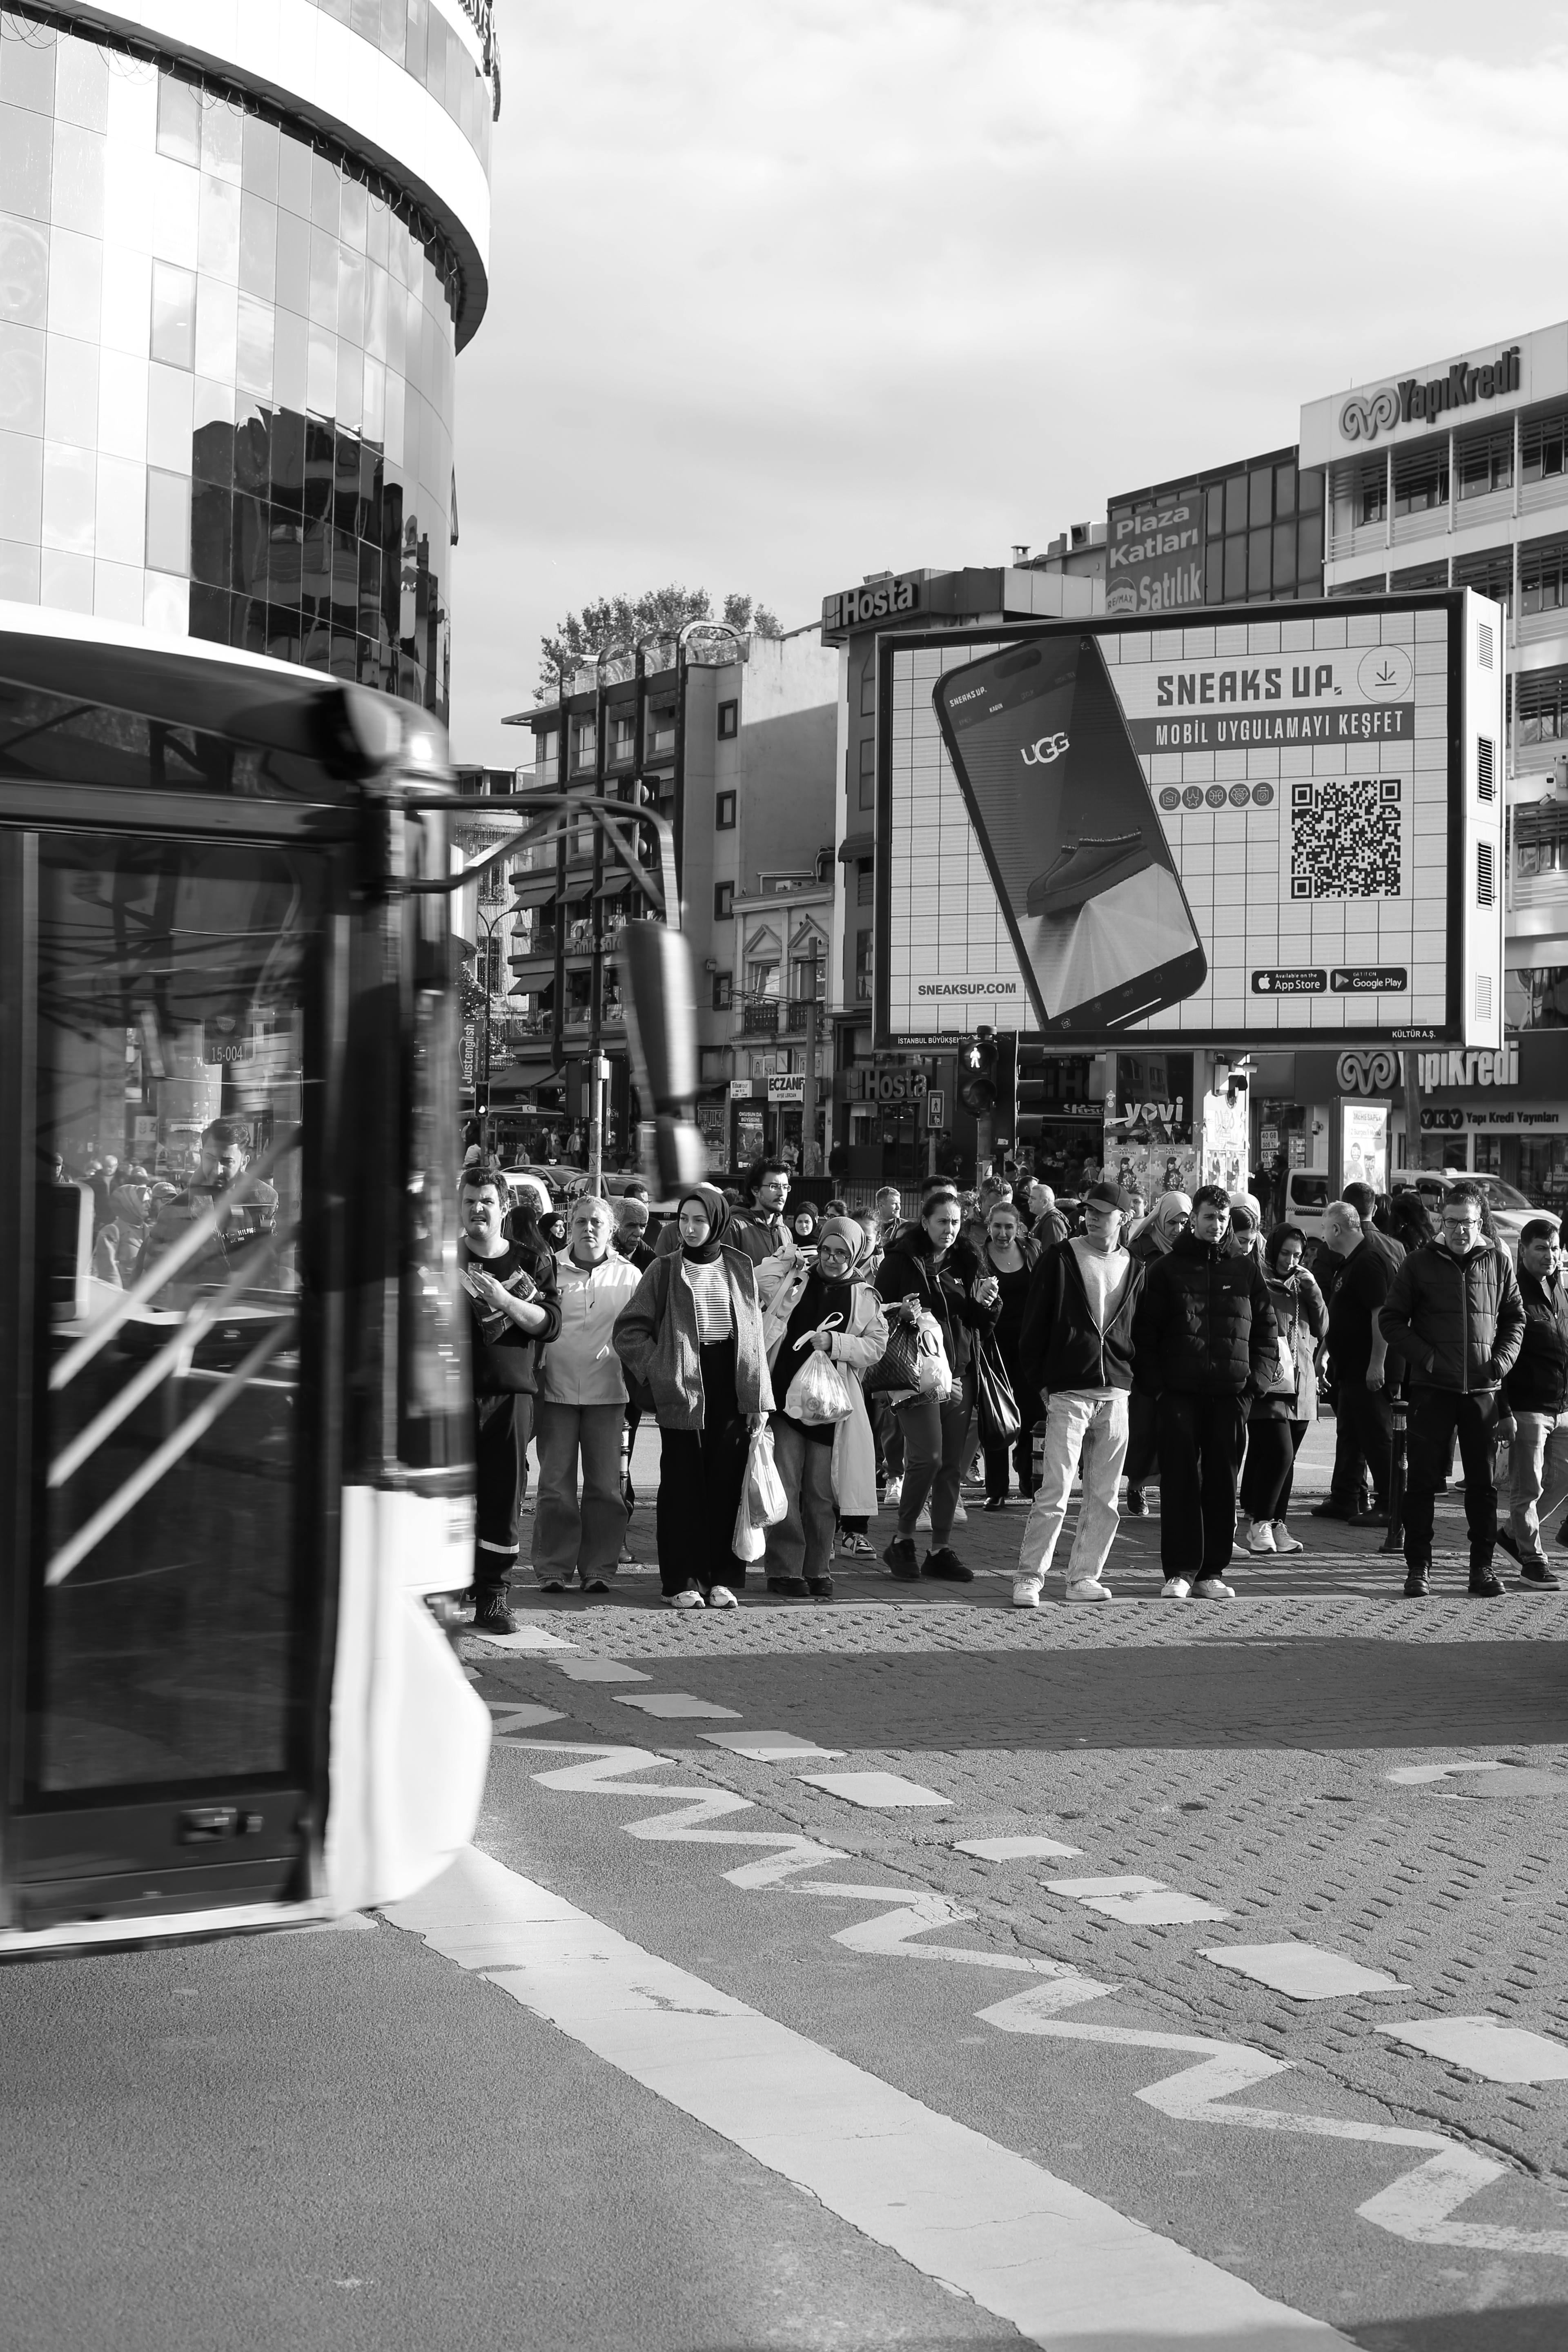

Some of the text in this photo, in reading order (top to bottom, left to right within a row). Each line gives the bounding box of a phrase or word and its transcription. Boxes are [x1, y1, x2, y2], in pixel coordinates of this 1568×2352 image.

[1397, 346, 1520, 423] YapıKredi
[1117, 507, 1189, 539] Plaza
[1110, 528, 1198, 568] Katları
[1139, 563, 1202, 612] Satılık
[842, 580, 914, 626] Hosta
[1107, 595, 1133, 610] RE/MAX
[1157, 668, 1281, 706] SNEAKS
[949, 690, 976, 707] SNEAKS
[989, 703, 1003, 713] KADIN
[1156, 710, 1403, 746] MOBİL UYGULAMAYI KEŞFET
[1020, 732, 1070, 765] UGG
[918, 983, 1016, 996] SNEAKSUP.COM
[1275, 980, 1321, 991] App Store
[1353, 978, 1402, 989] Google Play
[1422, 1030, 1436, 1039] A.Ş.
[212, 1046, 243, 1062] 15-004
[865, 1069, 927, 1098] Hosta
[1422, 1114, 1459, 1124] YKY
[1466, 1112, 1559, 1126] Yapı Kredi Yayınları
